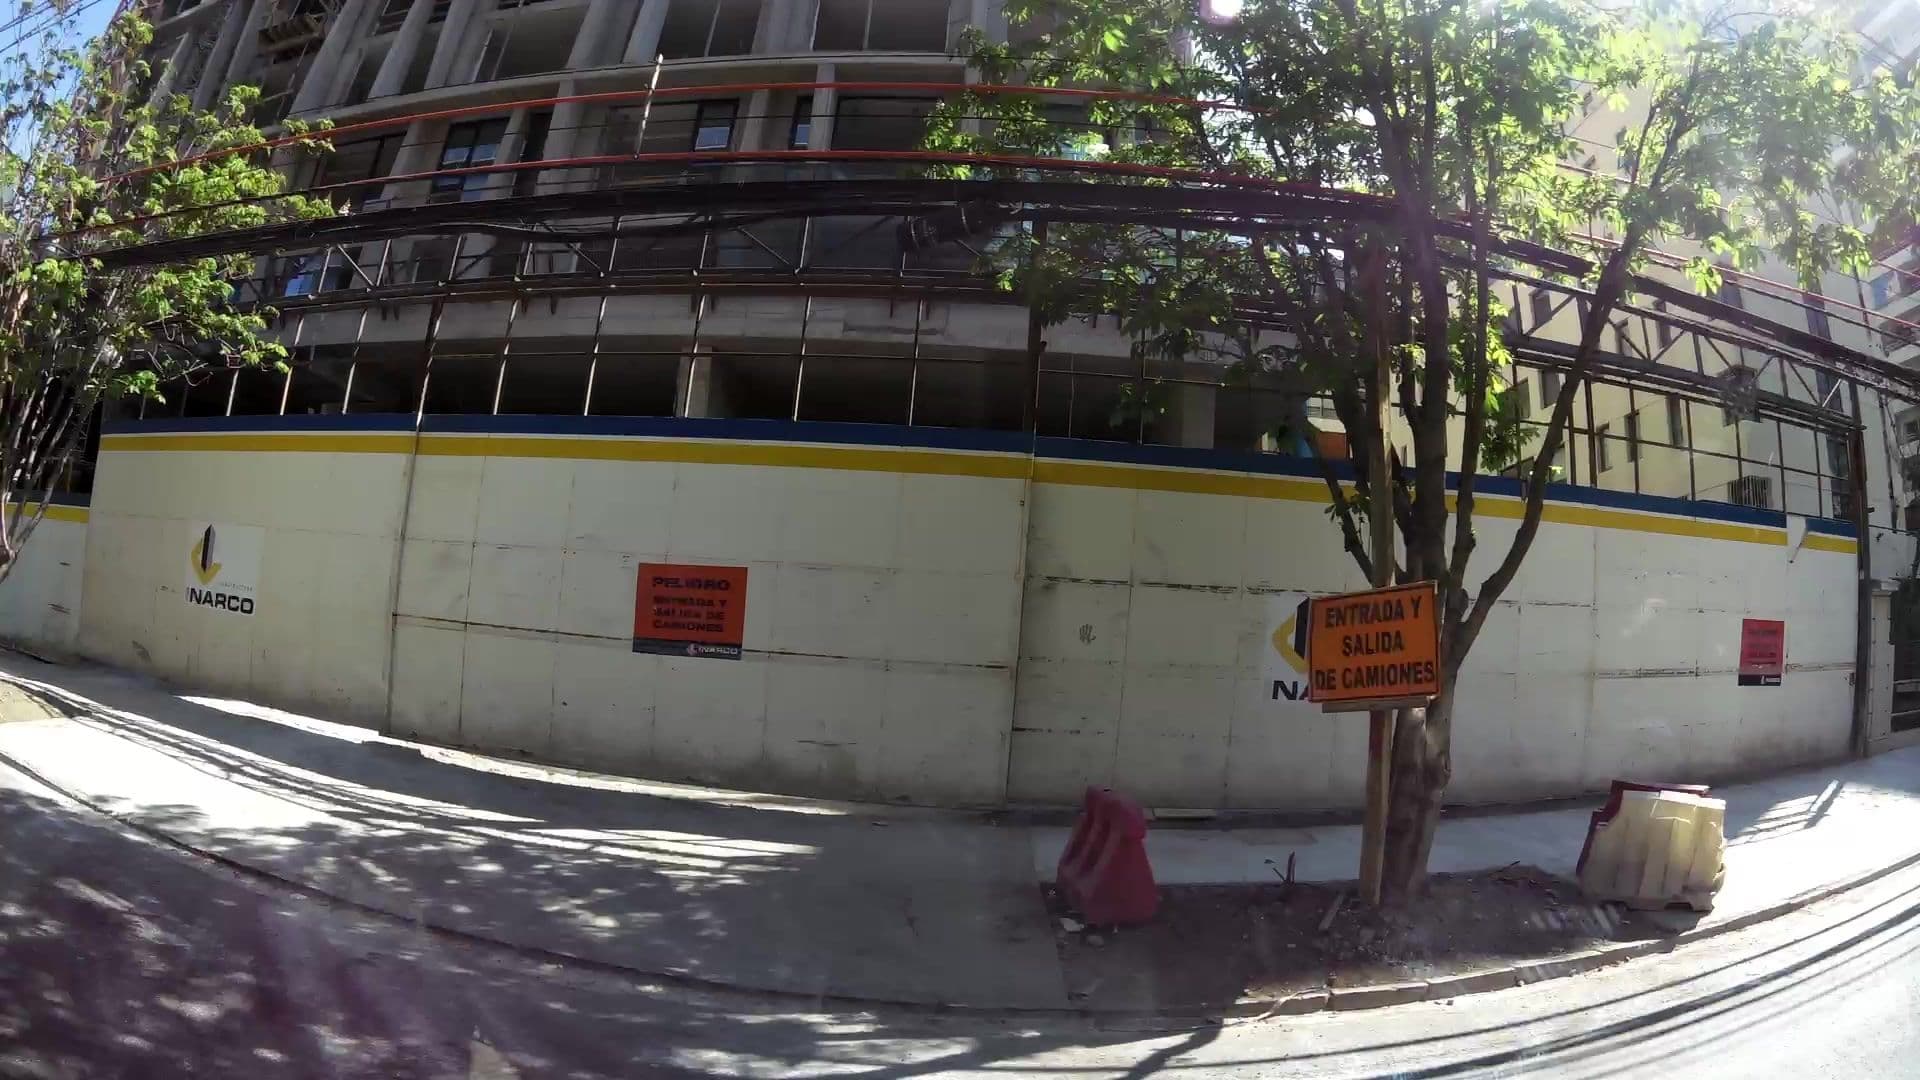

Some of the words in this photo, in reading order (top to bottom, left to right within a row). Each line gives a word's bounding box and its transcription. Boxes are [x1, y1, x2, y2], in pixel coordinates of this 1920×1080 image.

[652, 576, 730, 591] PELIGRO
[1325, 599, 1405, 629] ENTRADA
[1410, 595, 1422, 620] Y
[1341, 630, 1405, 657] SALIDA
[1314, 667, 1337, 691] DE
[1341, 659, 1435, 690] CAMIONES
